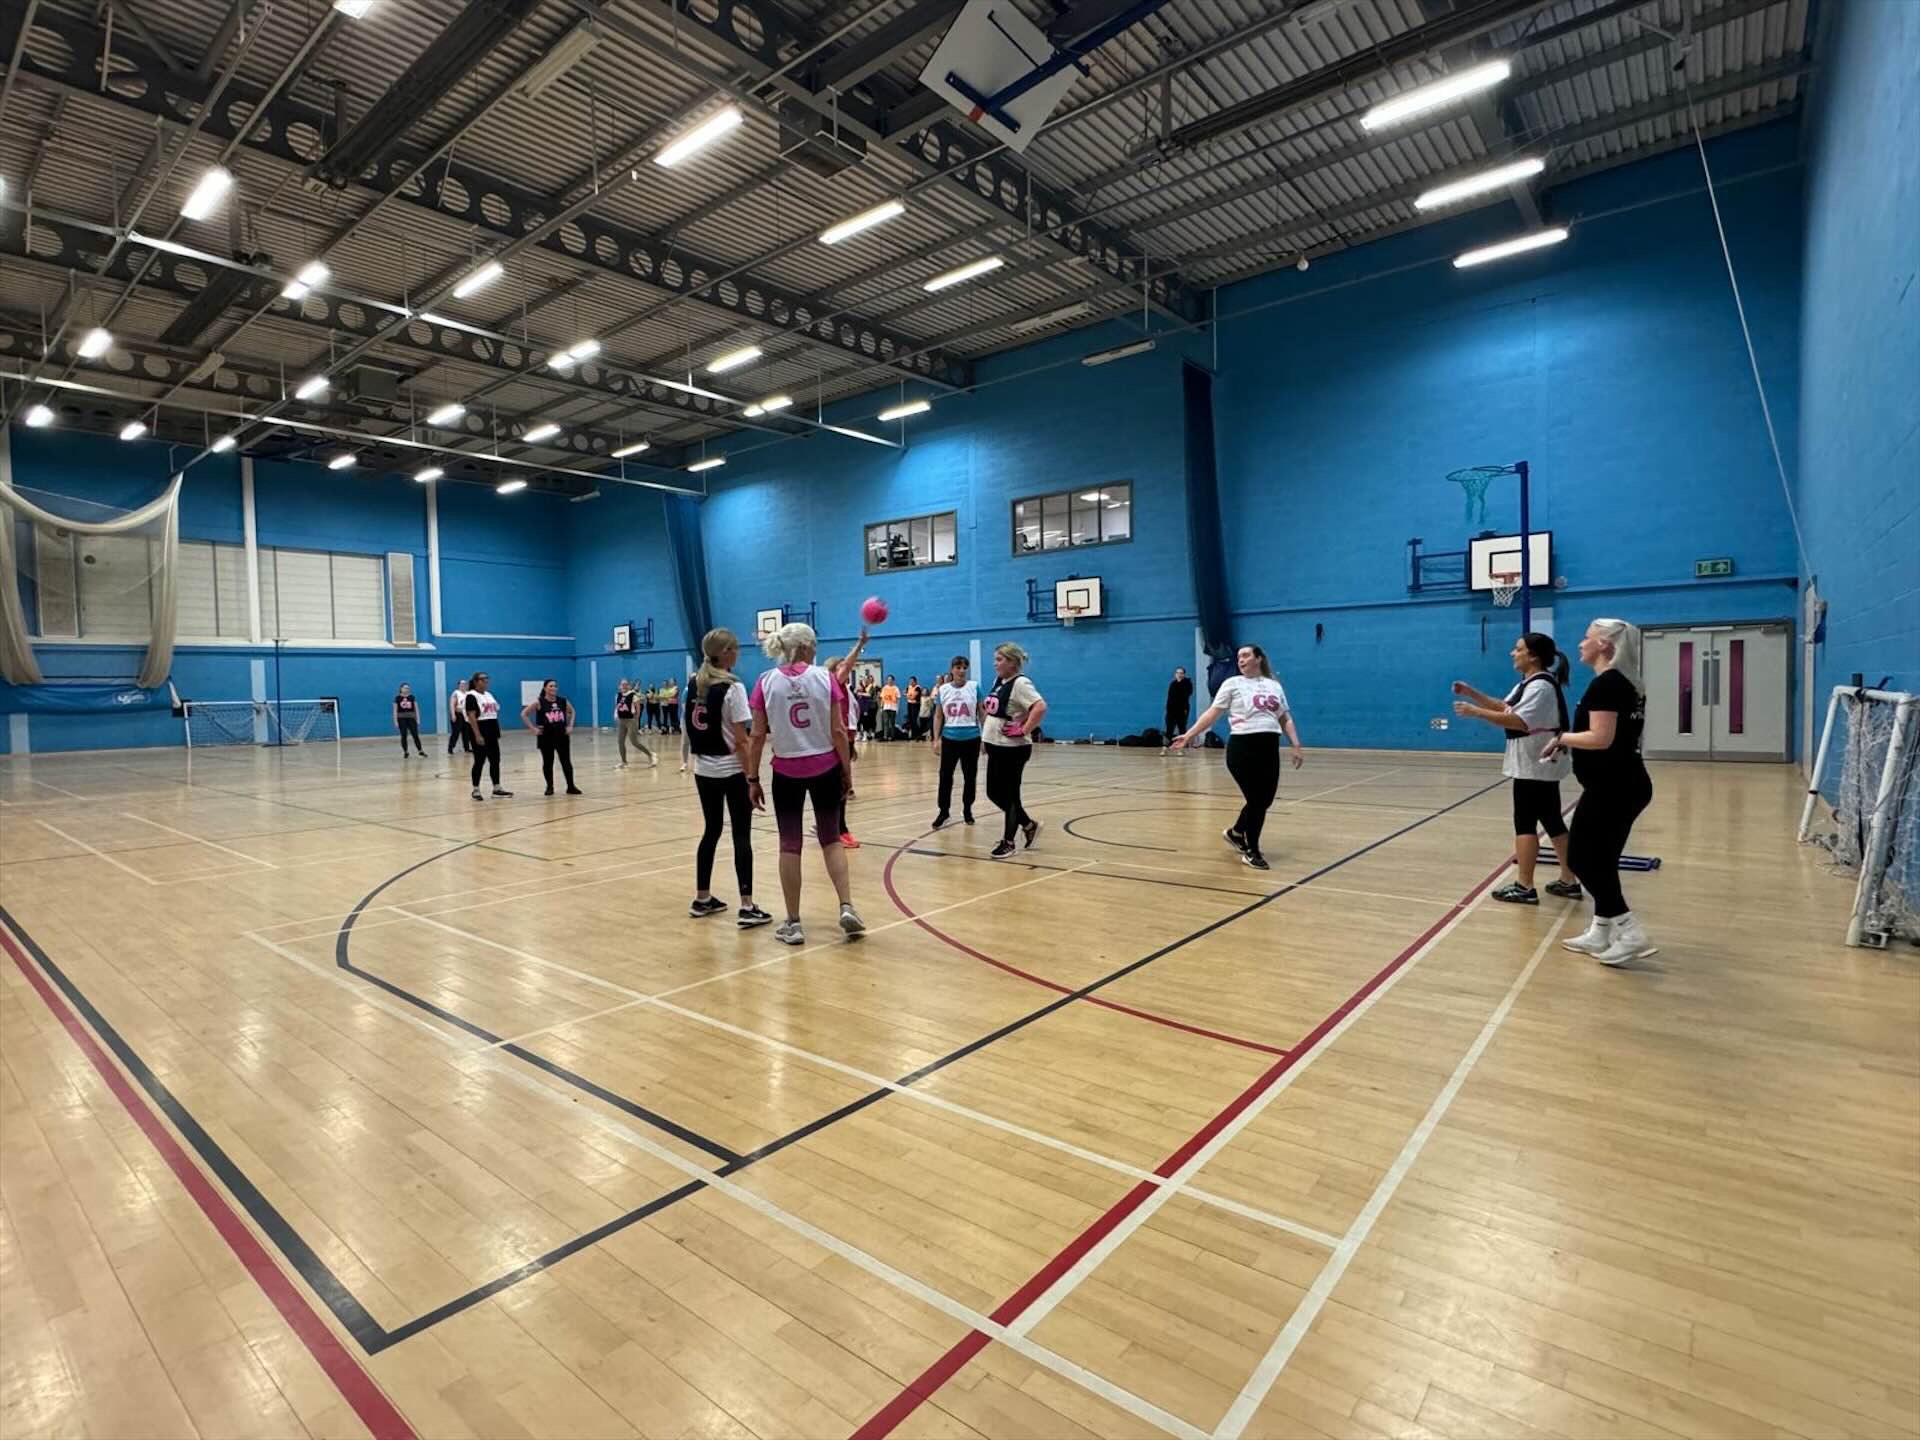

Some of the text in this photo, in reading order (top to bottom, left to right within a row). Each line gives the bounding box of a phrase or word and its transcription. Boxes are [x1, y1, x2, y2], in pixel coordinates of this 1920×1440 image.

[946, 702, 971, 717] GA
[1253, 694, 1280, 712] GS
[691, 704, 709, 731] C
[789, 702, 811, 729] C
